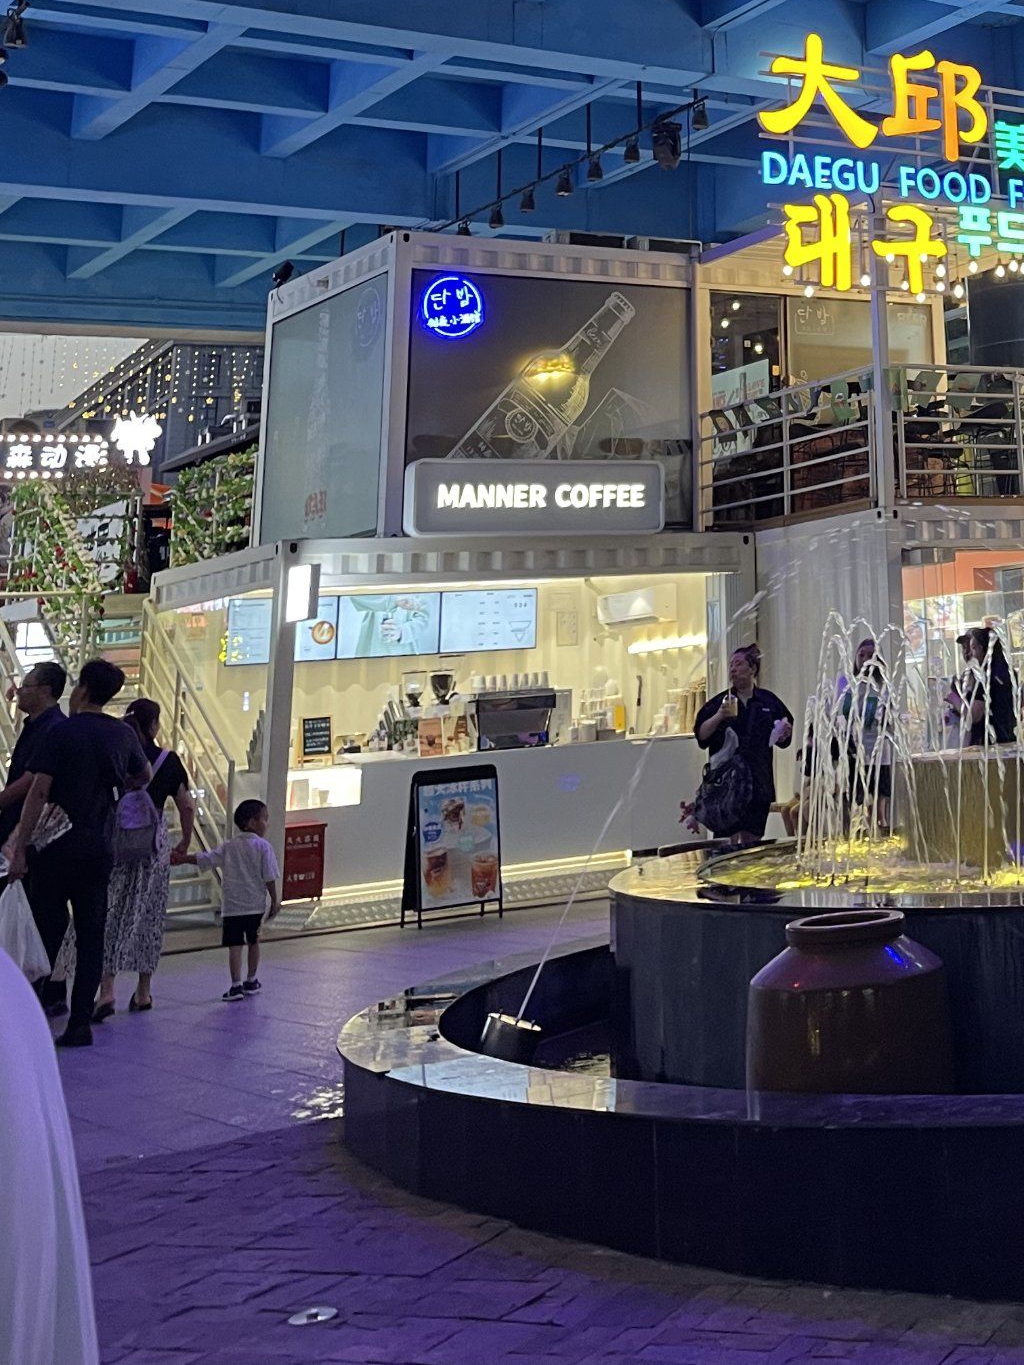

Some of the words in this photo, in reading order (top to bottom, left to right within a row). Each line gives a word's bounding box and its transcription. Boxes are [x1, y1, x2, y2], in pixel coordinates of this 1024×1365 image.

[761, 150, 880, 194] DAEGU
[900, 166, 992, 205] FOOD
[782, 193, 948, 295] 대구
[436, 483, 548, 509] MANNER
[554, 483, 646, 509] COFFEE
